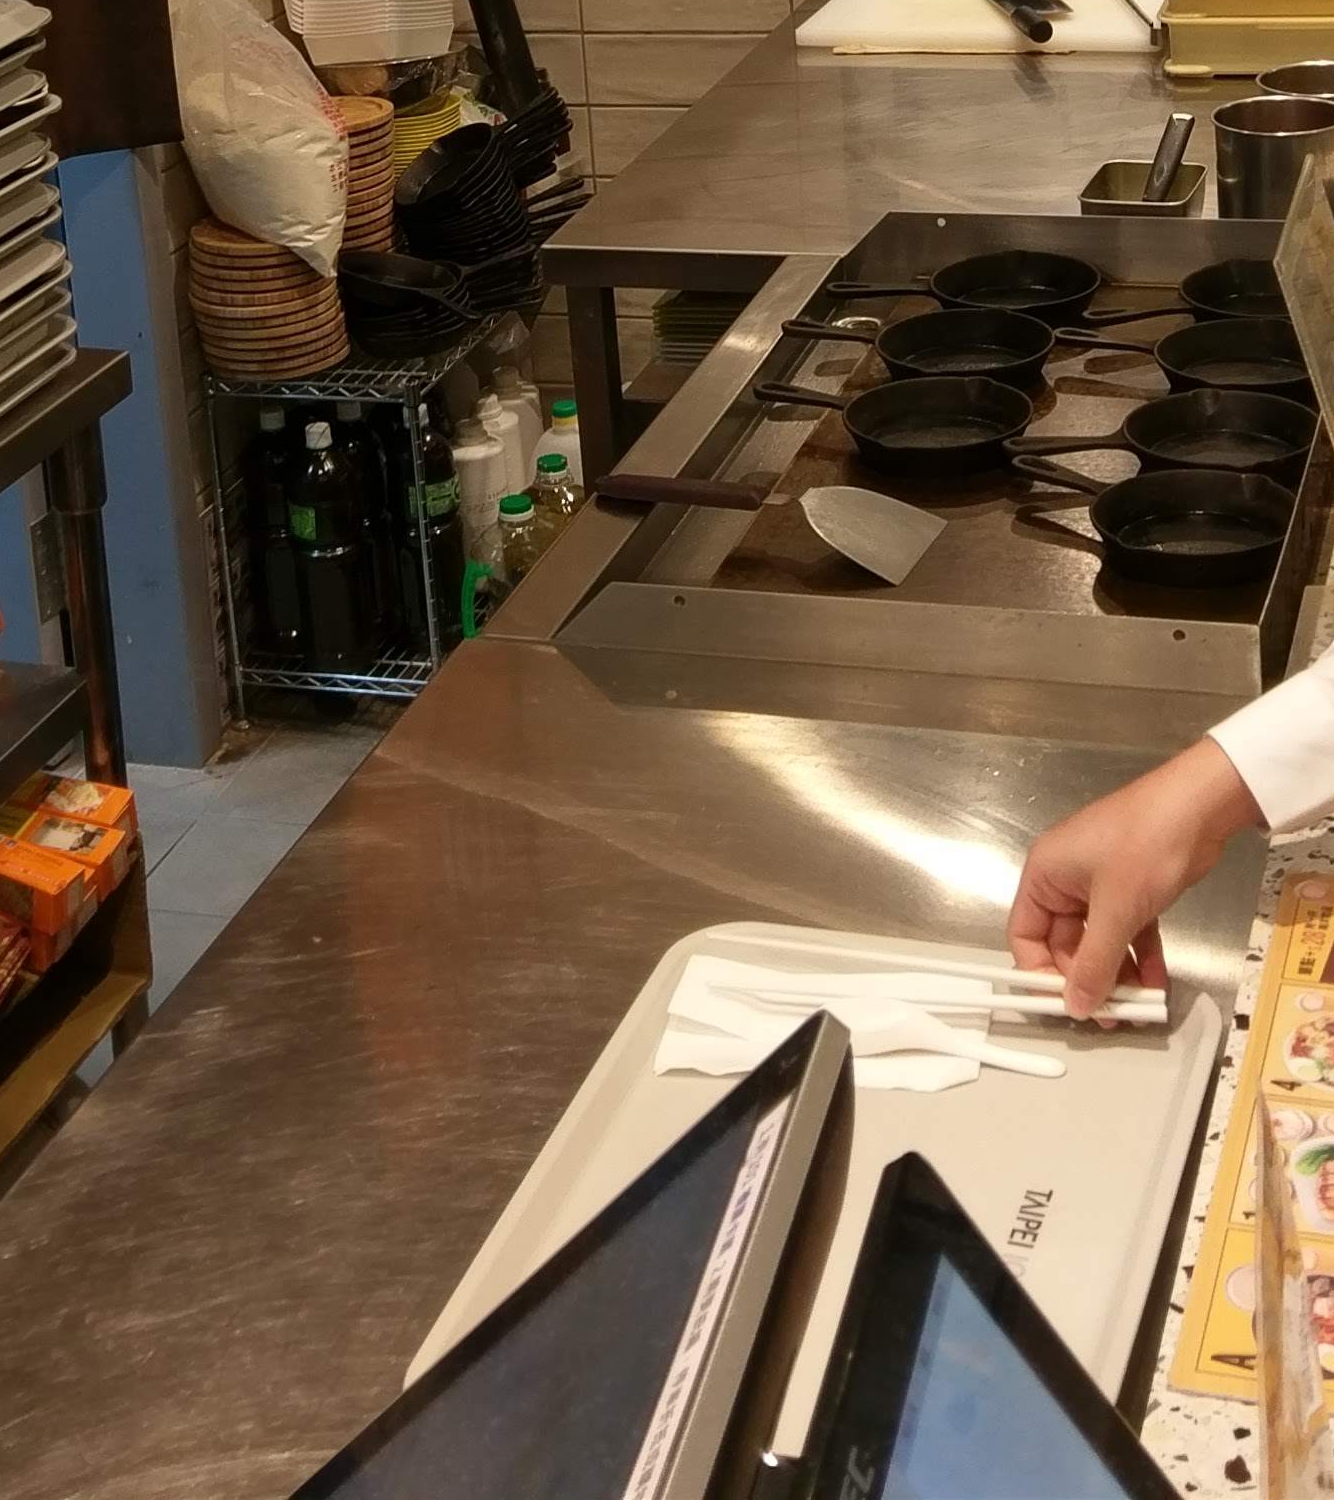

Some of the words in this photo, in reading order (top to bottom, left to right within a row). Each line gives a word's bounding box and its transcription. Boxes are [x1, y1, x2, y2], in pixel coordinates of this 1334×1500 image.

[1270, 1079, 1302, 1092] 4
[1007, 1188, 1054, 1249] TAIPEI
[1211, 1354, 1257, 1371] A
